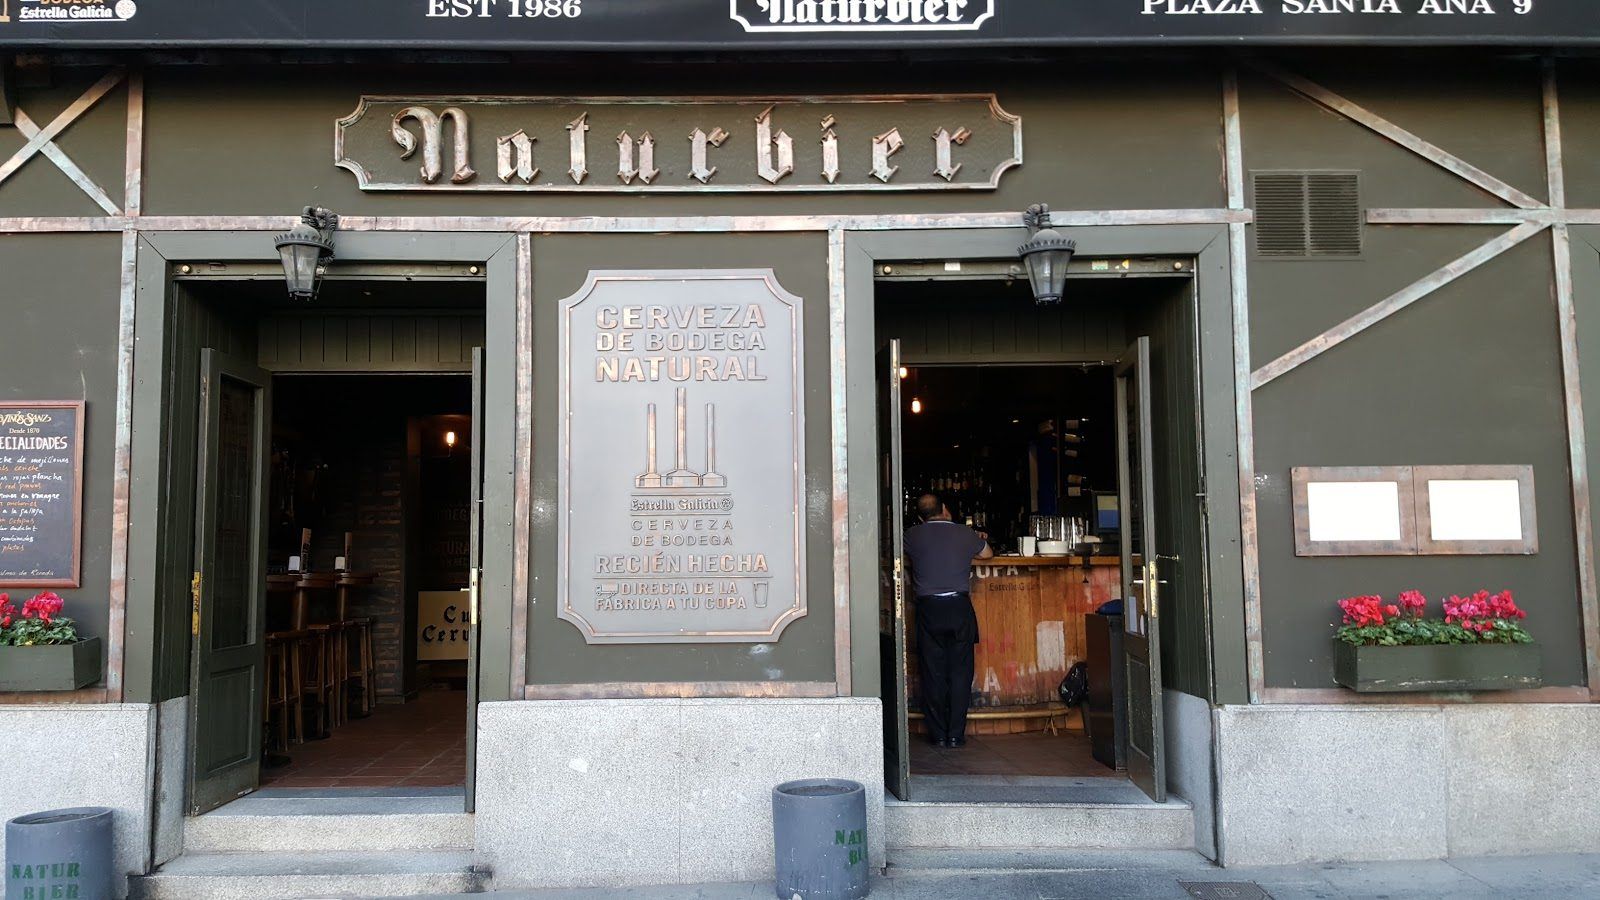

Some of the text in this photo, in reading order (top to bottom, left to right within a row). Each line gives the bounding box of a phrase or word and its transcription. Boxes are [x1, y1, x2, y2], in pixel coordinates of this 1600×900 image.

[19, 5, 113, 19] Estrella Galicia
[425, 0, 582, 18] EST 1986
[1140, 0, 1263, 14] PLAZA
[1417, 0, 1496, 14] ANA
[1513, 0, 1533, 14] 9
[392, 104, 972, 185] Naturbier
[596, 304, 766, 329] CERVEZA
[596, 331, 766, 351] DE BODEGA
[595, 355, 768, 382] NATURAL
[630, 498, 718, 511] Estrella Galicia
[631, 518, 733, 531] CERVEZA
[631, 534, 733, 546] DE BODEGA
[595, 552, 769, 574] RECIÉN HECHA
[621, 582, 738, 596] DIRECTA DE LA
[666, 597, 676, 610] A
[681, 597, 699, 610] TU
[704, 597, 747, 610] COPA
[11, 862, 80, 879] NATUR
[23, 883, 80, 900] BIER
